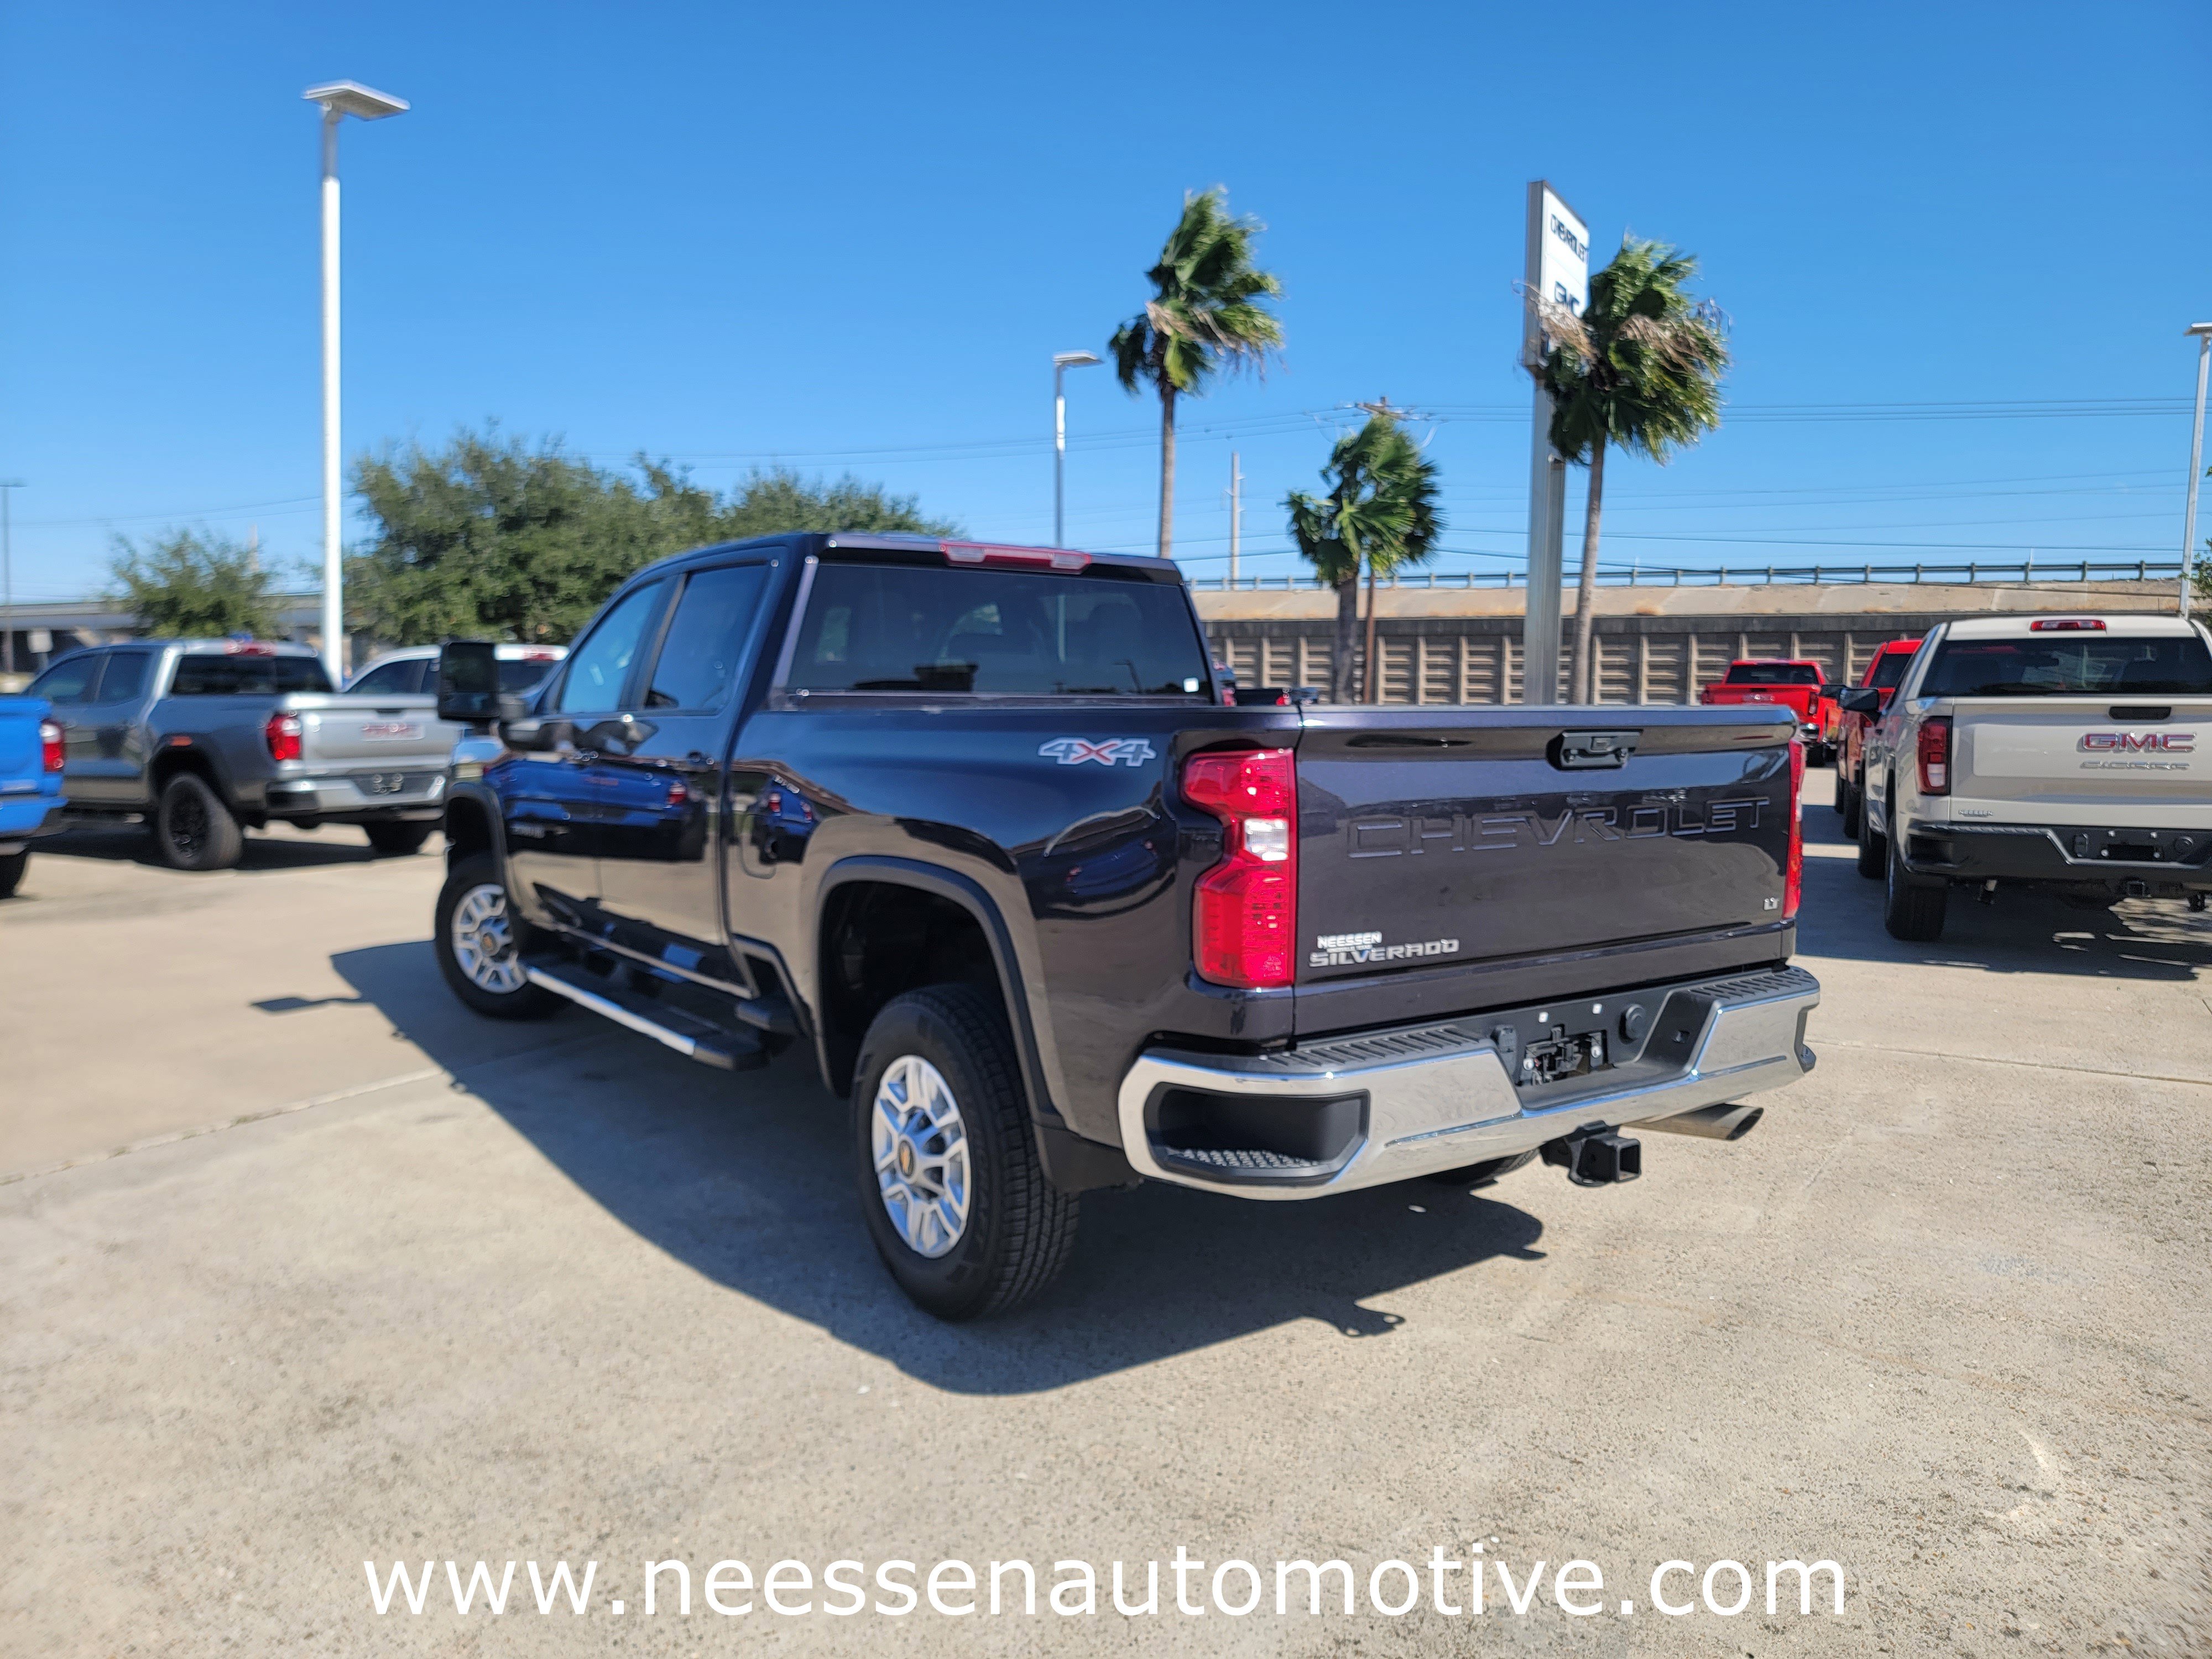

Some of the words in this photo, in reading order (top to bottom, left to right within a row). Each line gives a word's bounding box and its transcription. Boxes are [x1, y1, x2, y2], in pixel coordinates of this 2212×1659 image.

[2083, 733, 2197, 752] GMC
[1348, 797, 1770, 858] CHEVROLET
[1317, 931, 1383, 949] NEESSEN
[1309, 939, 1459, 967] SILVERADO
